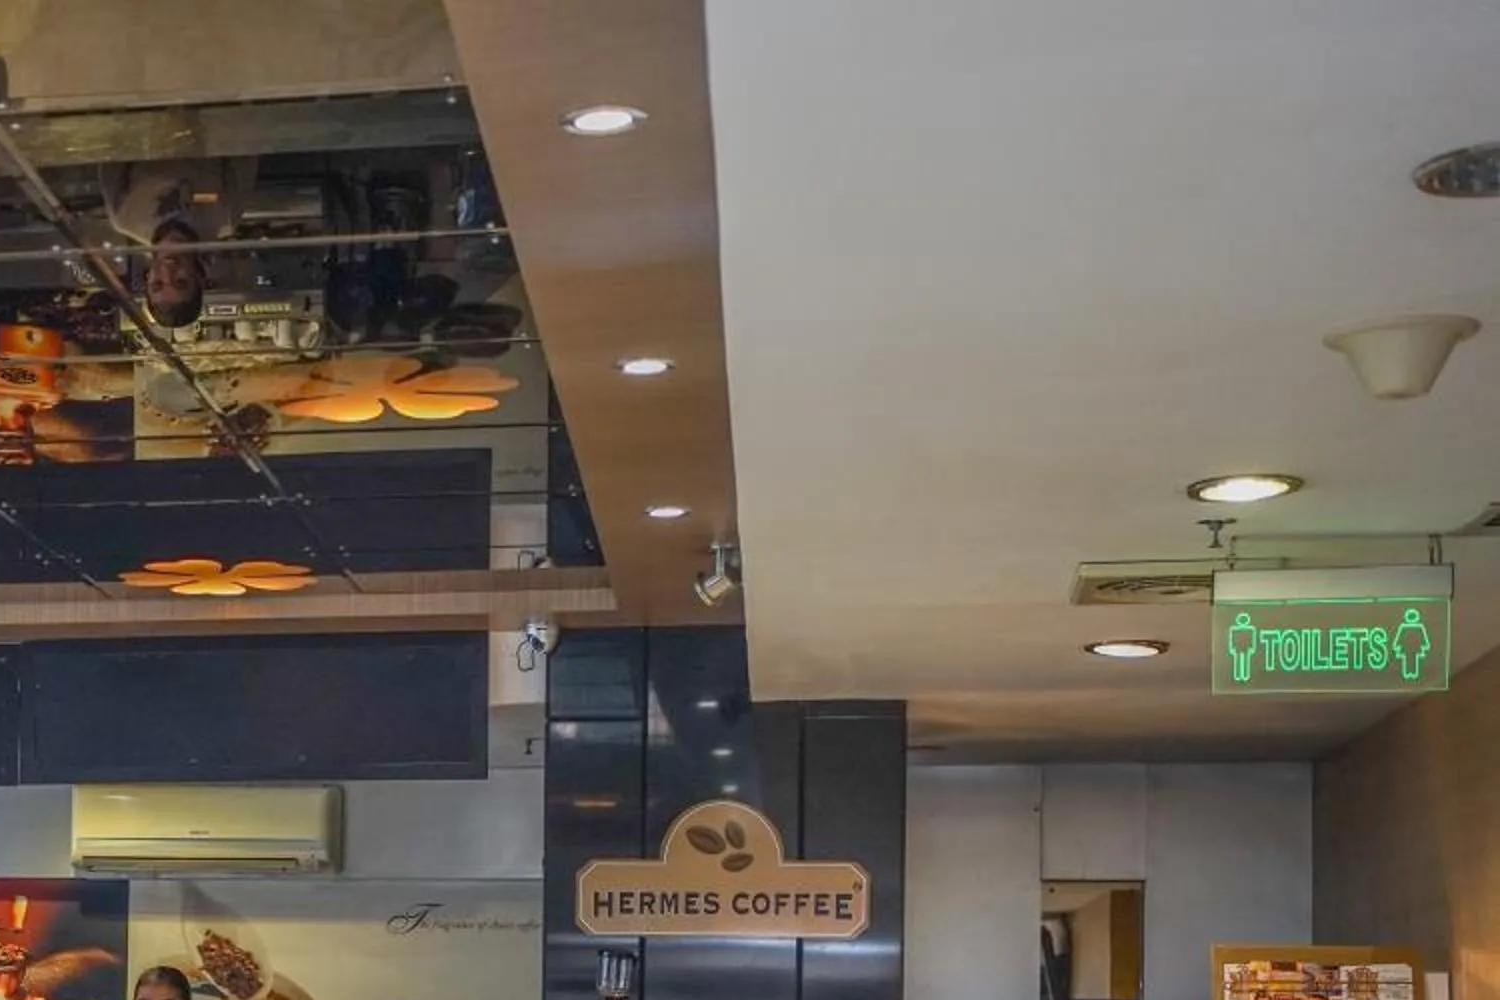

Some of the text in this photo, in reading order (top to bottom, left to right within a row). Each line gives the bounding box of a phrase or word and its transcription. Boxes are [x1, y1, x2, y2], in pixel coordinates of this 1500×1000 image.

[1260, 627, 1388, 670] TOILETS
[593, 891, 853, 919] HERMES COFFEE
